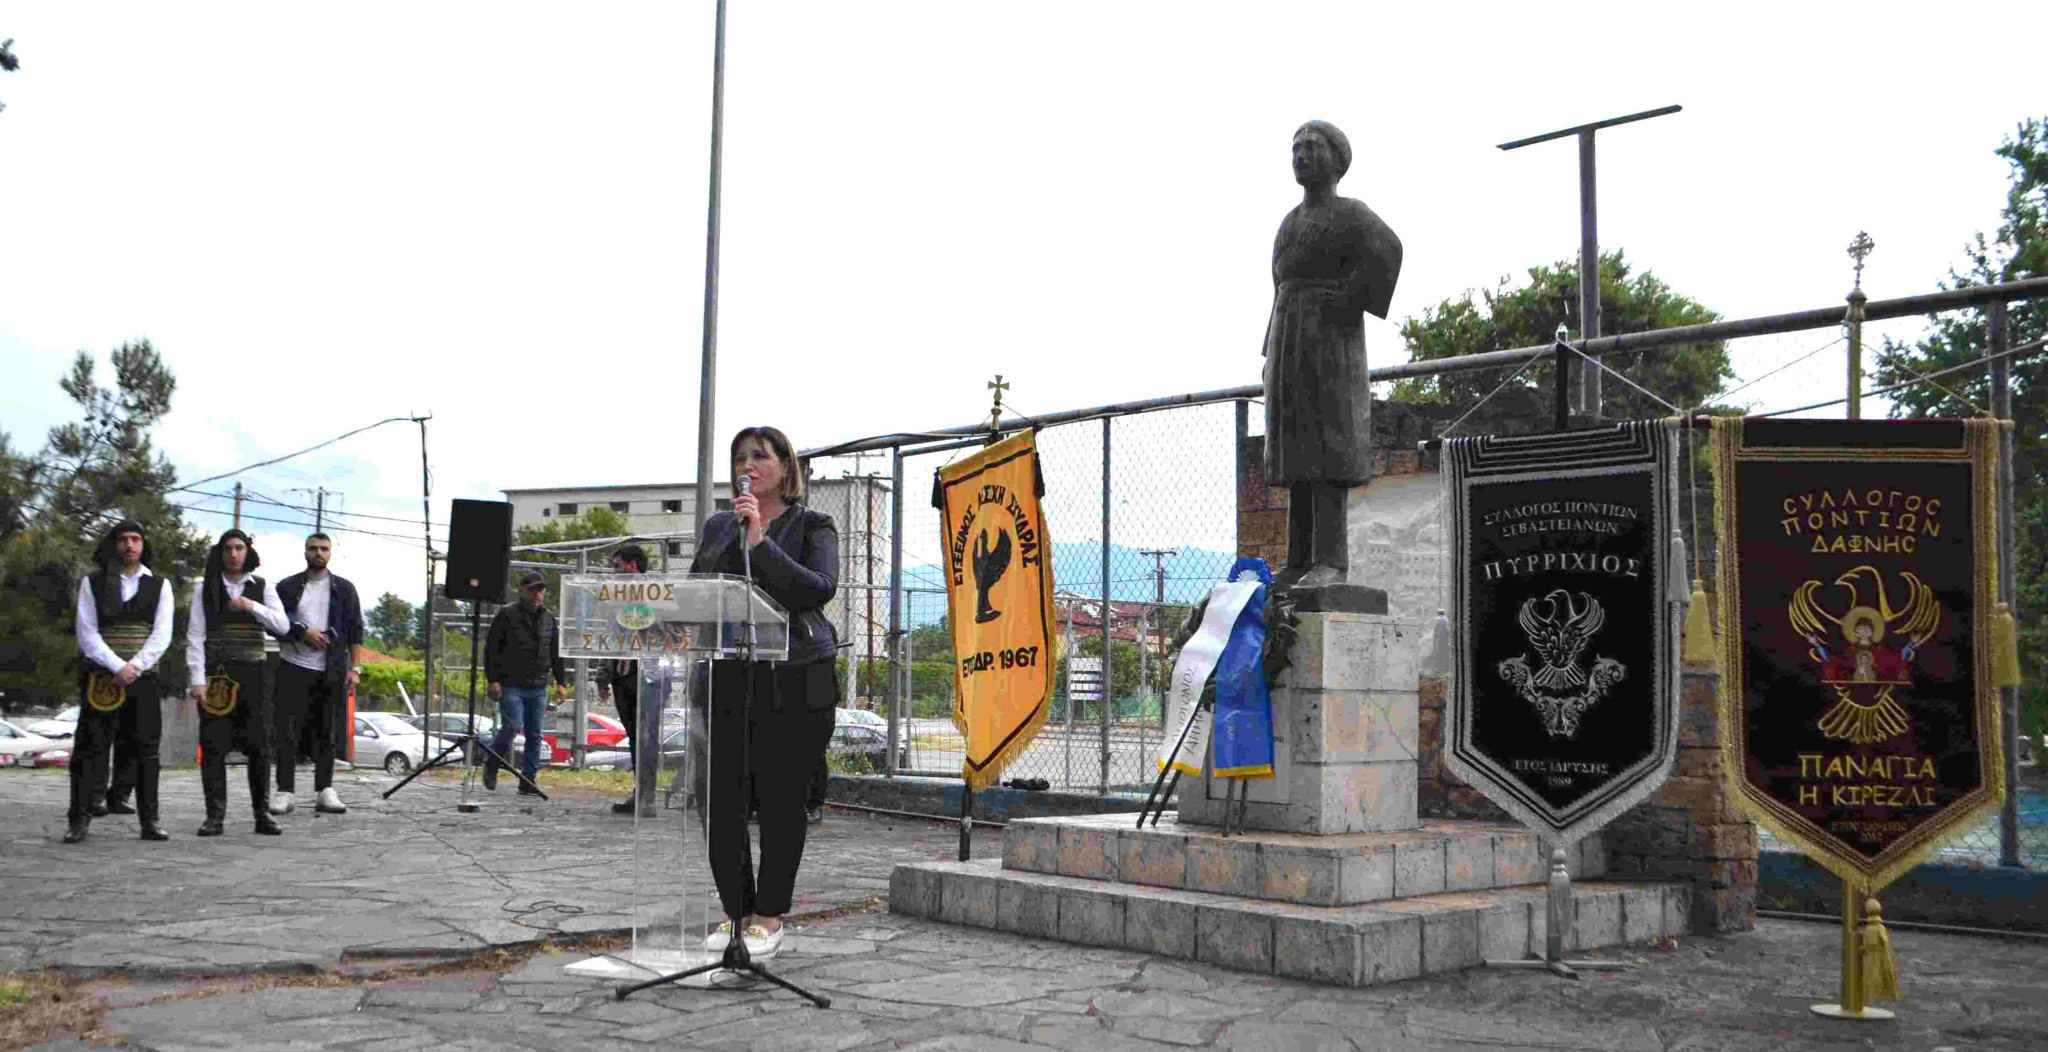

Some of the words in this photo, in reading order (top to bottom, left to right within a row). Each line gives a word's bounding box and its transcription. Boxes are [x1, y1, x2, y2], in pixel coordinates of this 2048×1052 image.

[1483, 552, 1641, 581] ΠΥΡΡΙΧΙΟΣ
[599, 583, 675, 601] ΔΗΜΟΣ
[999, 646, 1038, 670] 1967
[1797, 754, 1937, 779] ΠΑΝΑΓΙΑ
[1799, 785, 1818, 806] Η
